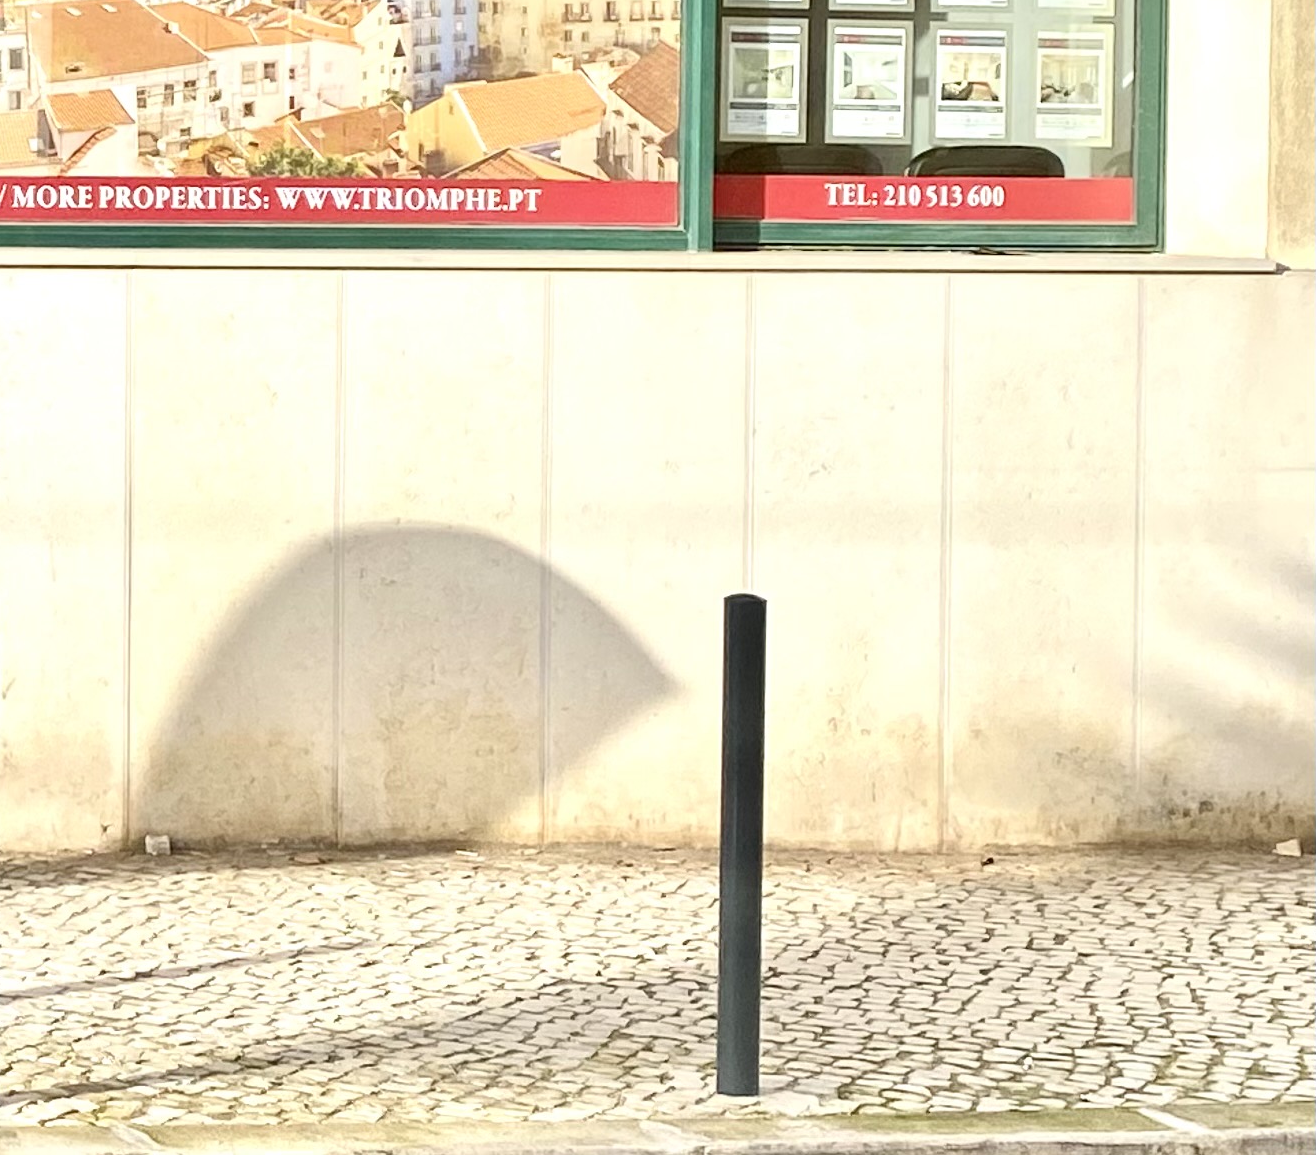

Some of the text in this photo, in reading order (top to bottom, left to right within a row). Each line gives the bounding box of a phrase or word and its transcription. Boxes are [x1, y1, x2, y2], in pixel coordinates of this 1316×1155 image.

[12, 185, 94, 210] MORE
[99, 185, 270, 211] PROPERTIES:
[275, 186, 543, 213] WWW.TRIOMPHE.PT
[824, 182, 1005, 208] TEL: 210 513 600
